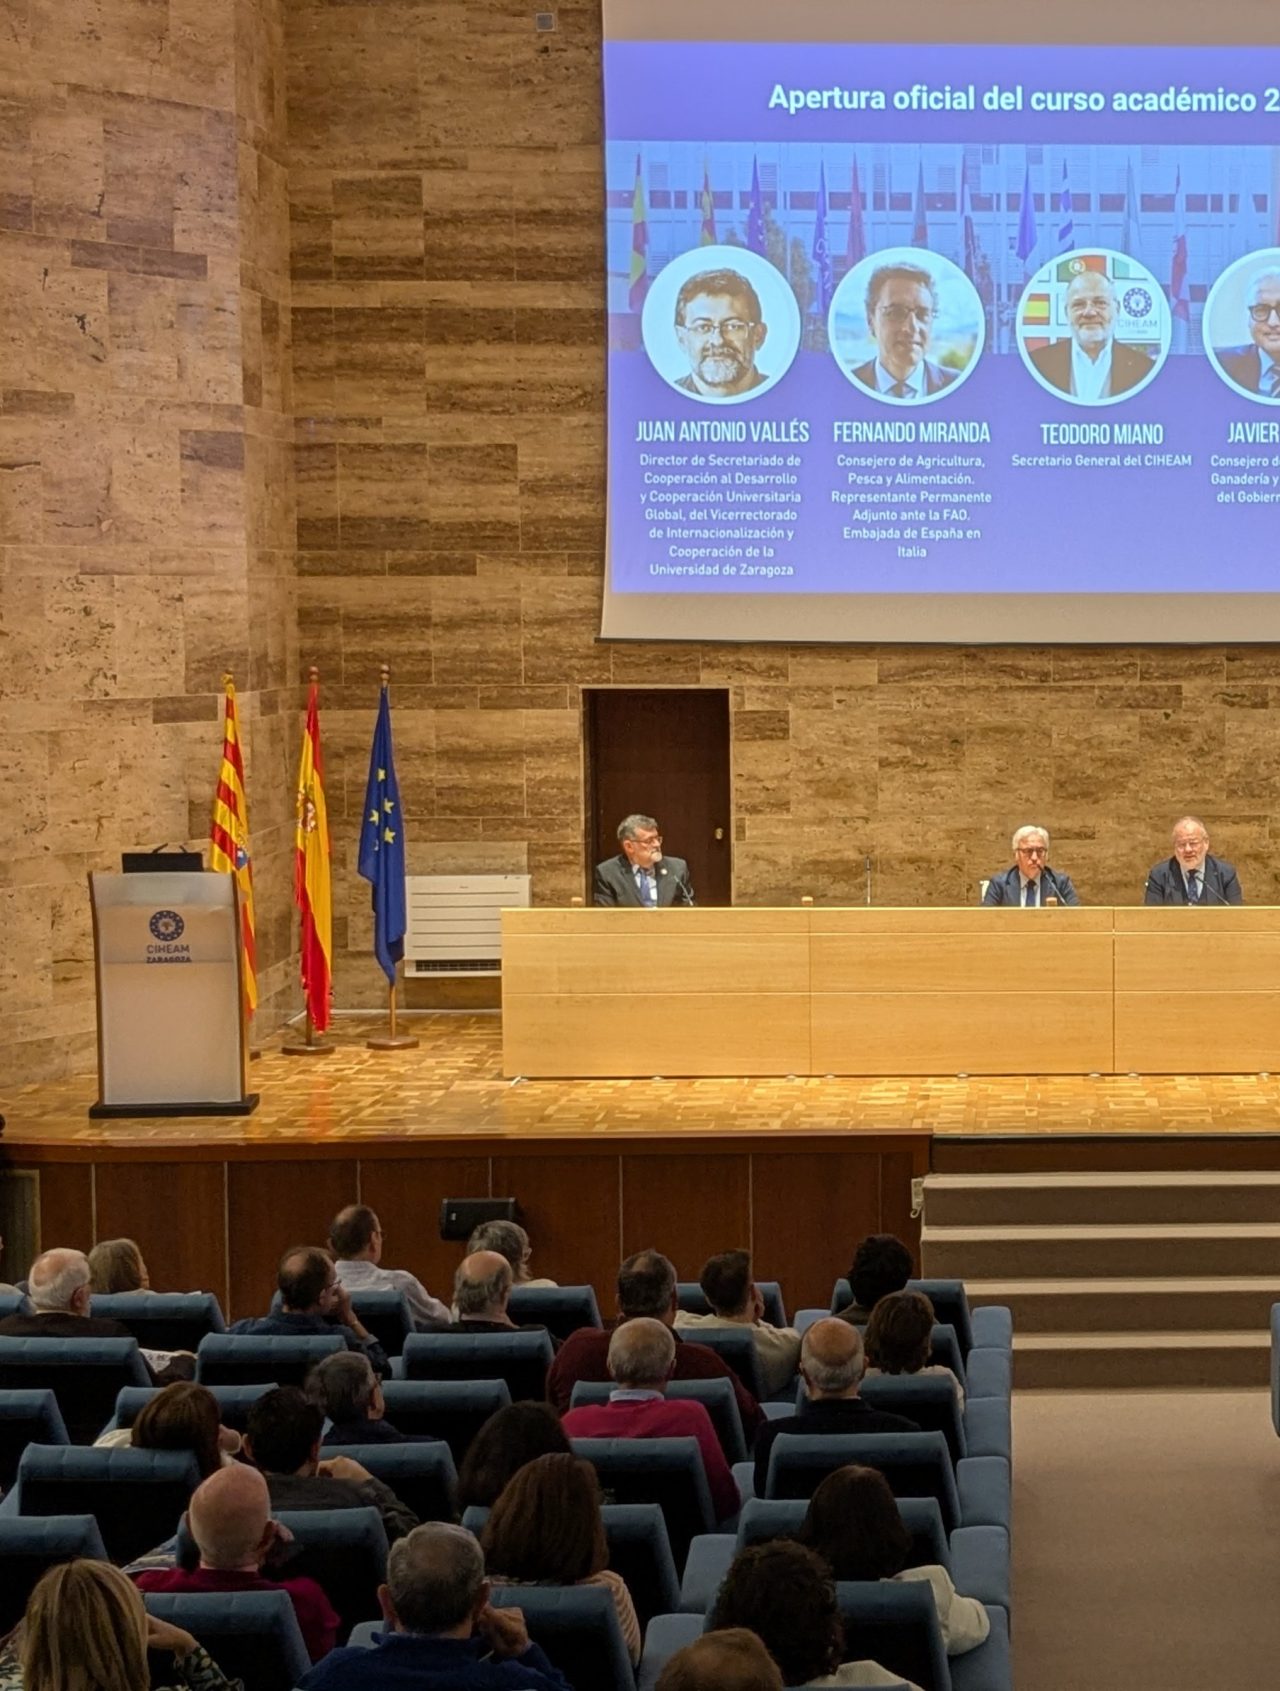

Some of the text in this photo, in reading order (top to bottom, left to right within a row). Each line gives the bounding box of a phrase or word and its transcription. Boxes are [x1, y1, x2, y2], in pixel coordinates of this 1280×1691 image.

[768, 85, 886, 114] Apertura
[893, 85, 975, 109] oficial
[982, 86, 1023, 110] del
[1030, 92, 1105, 110] curso
[1112, 87, 1257, 111] académico
[635, 418, 810, 442] JUAN ANTONIO VALLÉS
[833, 422, 991, 442] FERNANDO MIRANDA
[1039, 424, 1164, 444] TEODORO MIANO
[1227, 423, 1280, 442] JAVIER
[639, 453, 801, 466] Director de Secretariado de
[836, 454, 986, 470] Consejero de Agricultura,
[1011, 453, 1192, 467] Secretario General del CIHEAM
[1210, 454, 1270, 470] Consejero
[644, 471, 798, 487] Cooperación al Desarrollo
[848, 472, 975, 487] Pesca y Alimentación.
[1210, 472, 1270, 485] Ganadería
[1272, 475, 1280, 488] y
[639, 489, 802, 505] y Cooperación Universitaria
[831, 490, 992, 505] Representante Permanente
[1216, 491, 1235, 503] del
[644, 507, 798, 522] Global, del Vicerrectorado
[852, 508, 970, 524] Adjunto ante la FAO.
[648, 526, 794, 542] de Internacionalización y
[843, 526, 981, 542] Embajada de España en
[668, 545, 775, 560] Cooperación de la
[897, 545, 927, 558] Italia
[649, 563, 794, 578] Universidad de Zaragoza
[146, 944, 191, 954] CIHEAM
